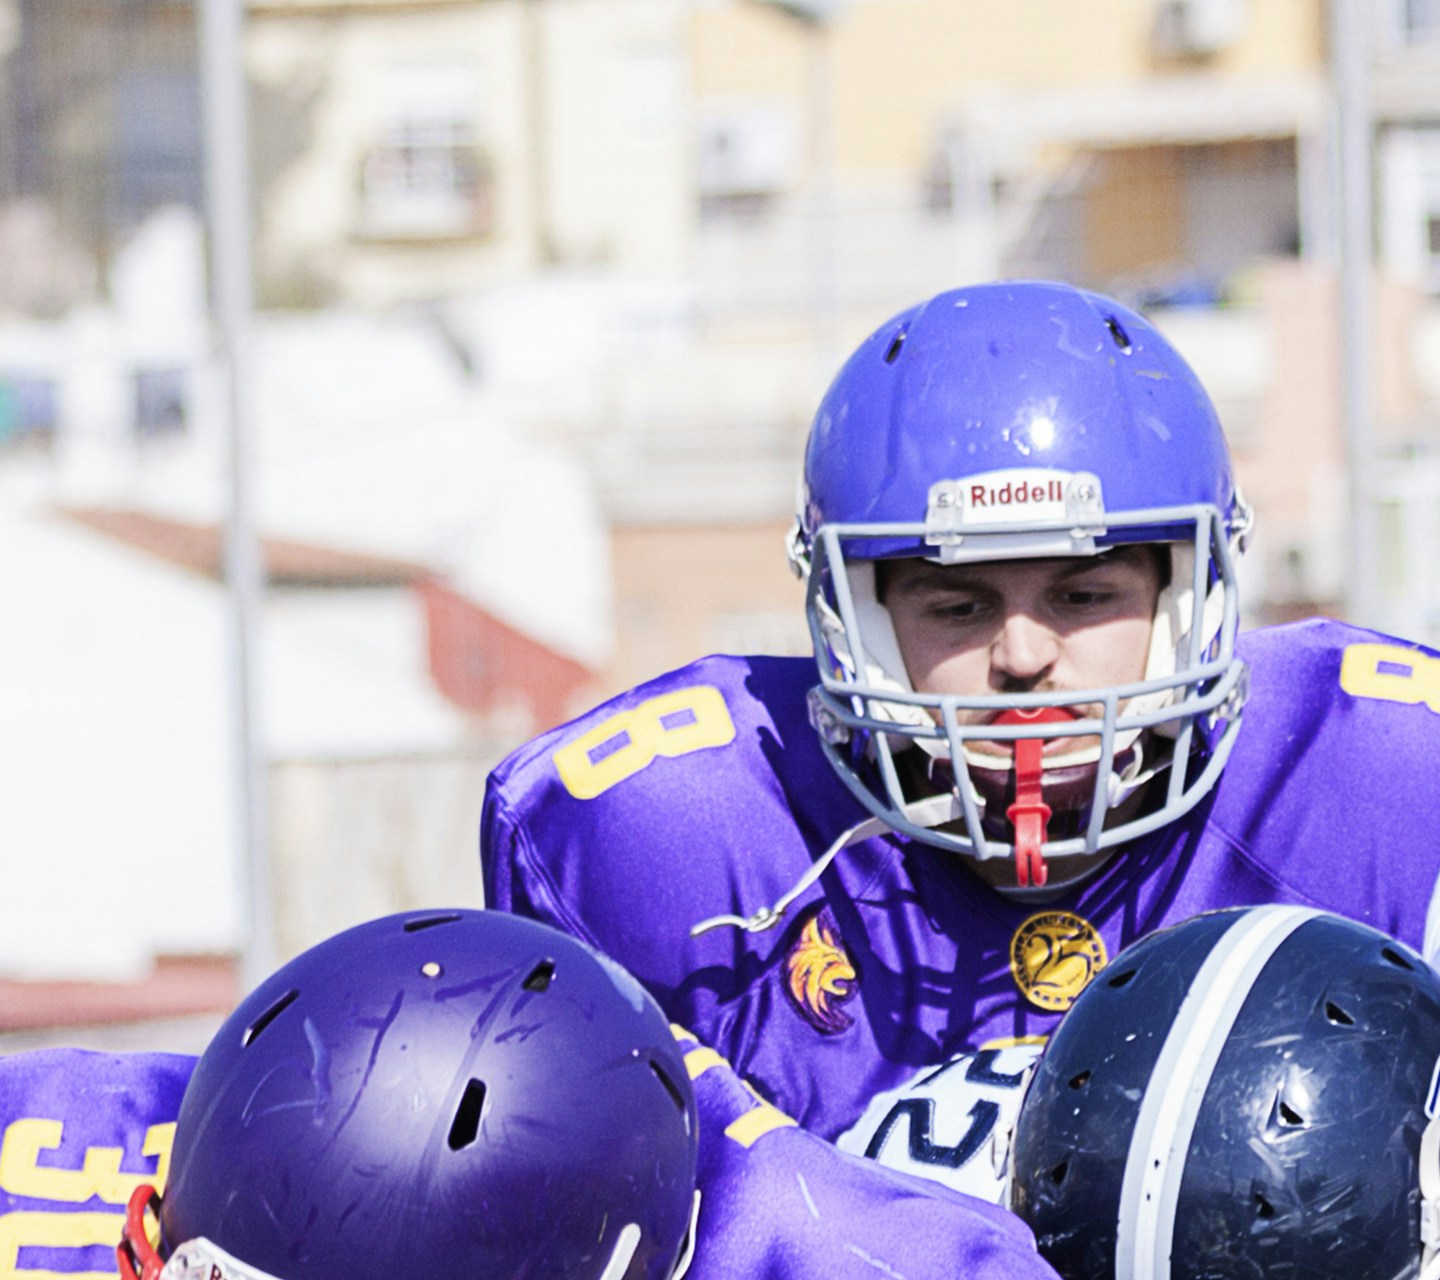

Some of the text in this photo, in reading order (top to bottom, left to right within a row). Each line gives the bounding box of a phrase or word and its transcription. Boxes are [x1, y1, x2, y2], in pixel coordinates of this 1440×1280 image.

[971, 480, 1063, 508] Riddell
[553, 684, 736, 801] 8
[1026, 933, 1092, 988] 25
